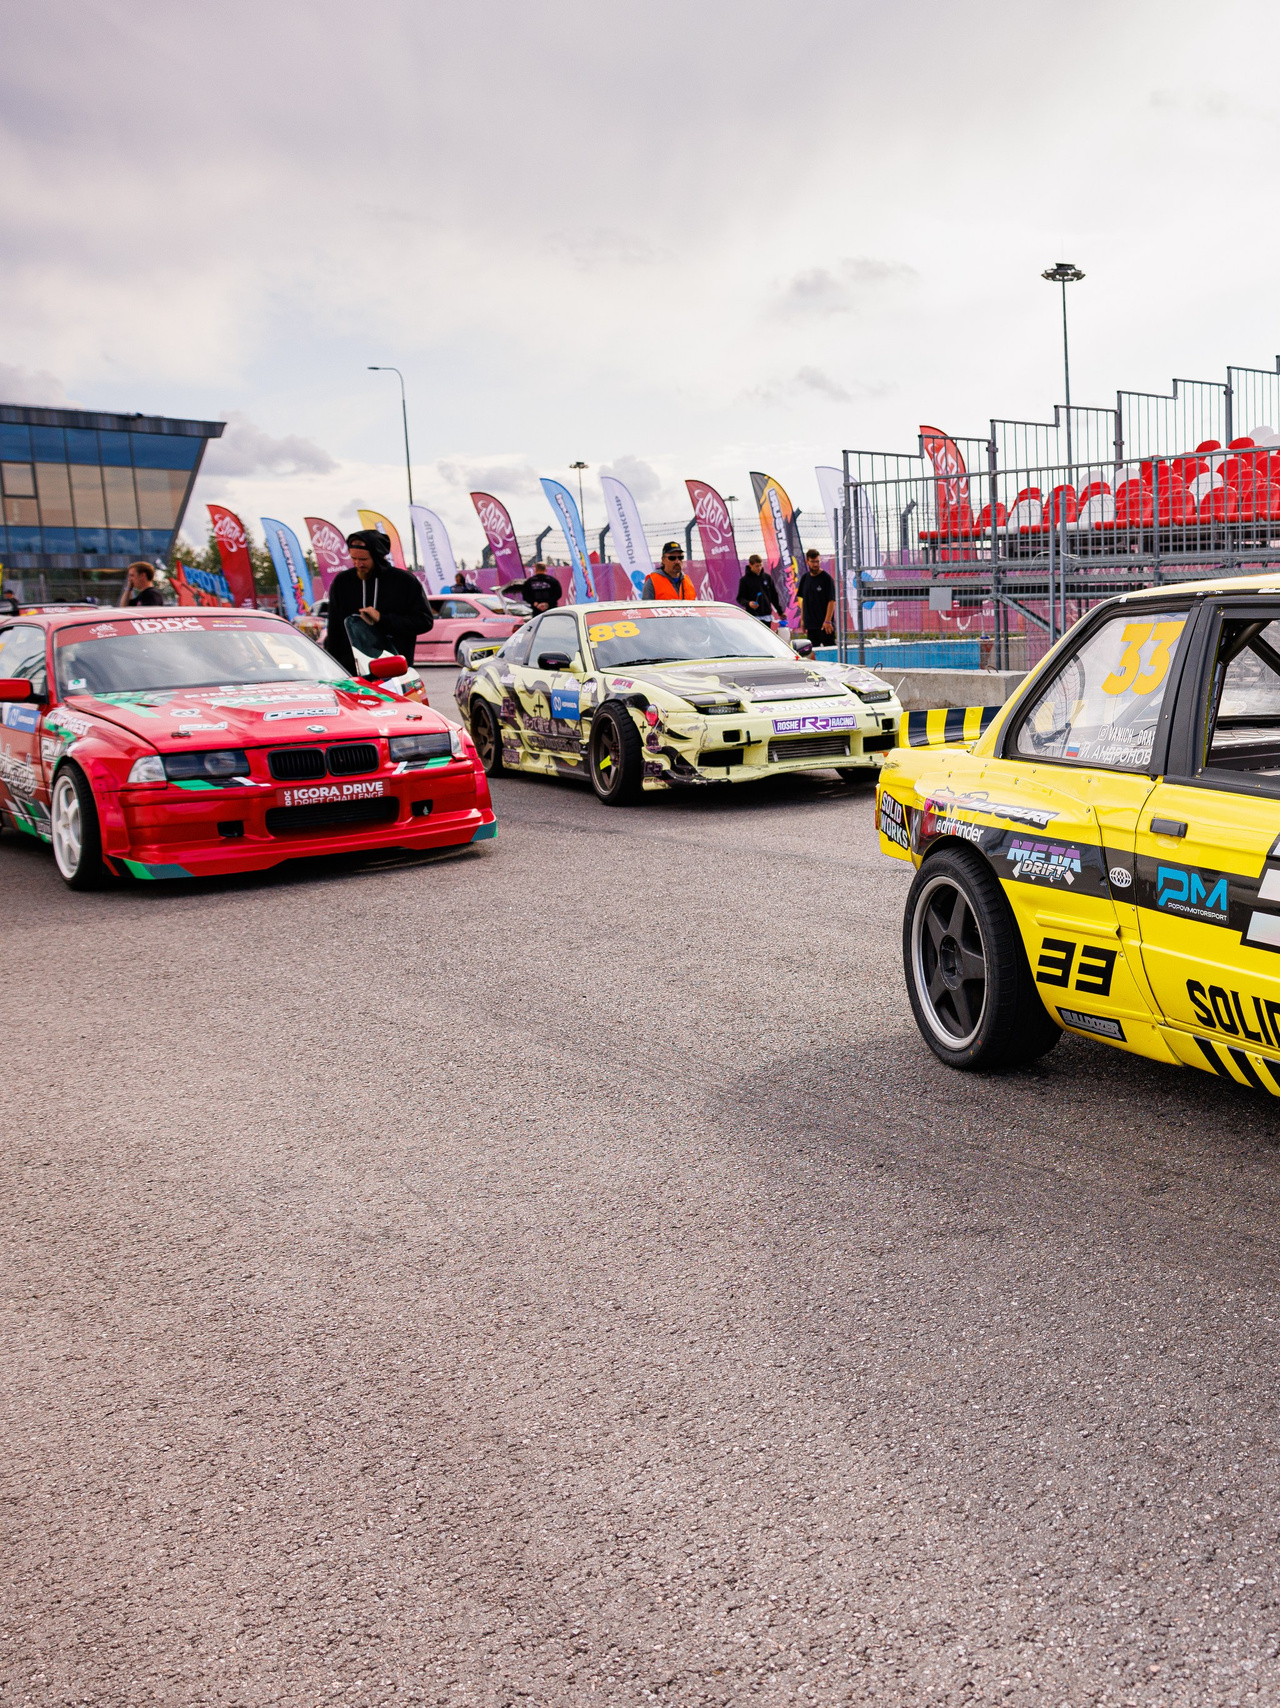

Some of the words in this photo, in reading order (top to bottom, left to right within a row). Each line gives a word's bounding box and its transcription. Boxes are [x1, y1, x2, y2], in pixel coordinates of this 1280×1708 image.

[131, 619, 203, 632] IDDC
[589, 621, 640, 642] 88
[1101, 621, 1186, 695] 33
[777, 719, 799, 731] ROSHE
[831, 716, 854, 727] RACING
[1091, 745, 1153, 765] АНДРОНОВ
[293, 785, 341, 800] IGORA
[342, 781, 384, 795] DRIVE
[881, 791, 903, 824] SOLID
[881, 811, 908, 849] WORKS
[1022, 859, 1066, 878] DRIFT
[1157, 866, 1228, 911] PM
[1167, 902, 1228, 921] POPOVMOTORSPORT
[1036, 936, 1120, 997] 33
[1061, 1009, 1123, 1039] BULLDOZER
